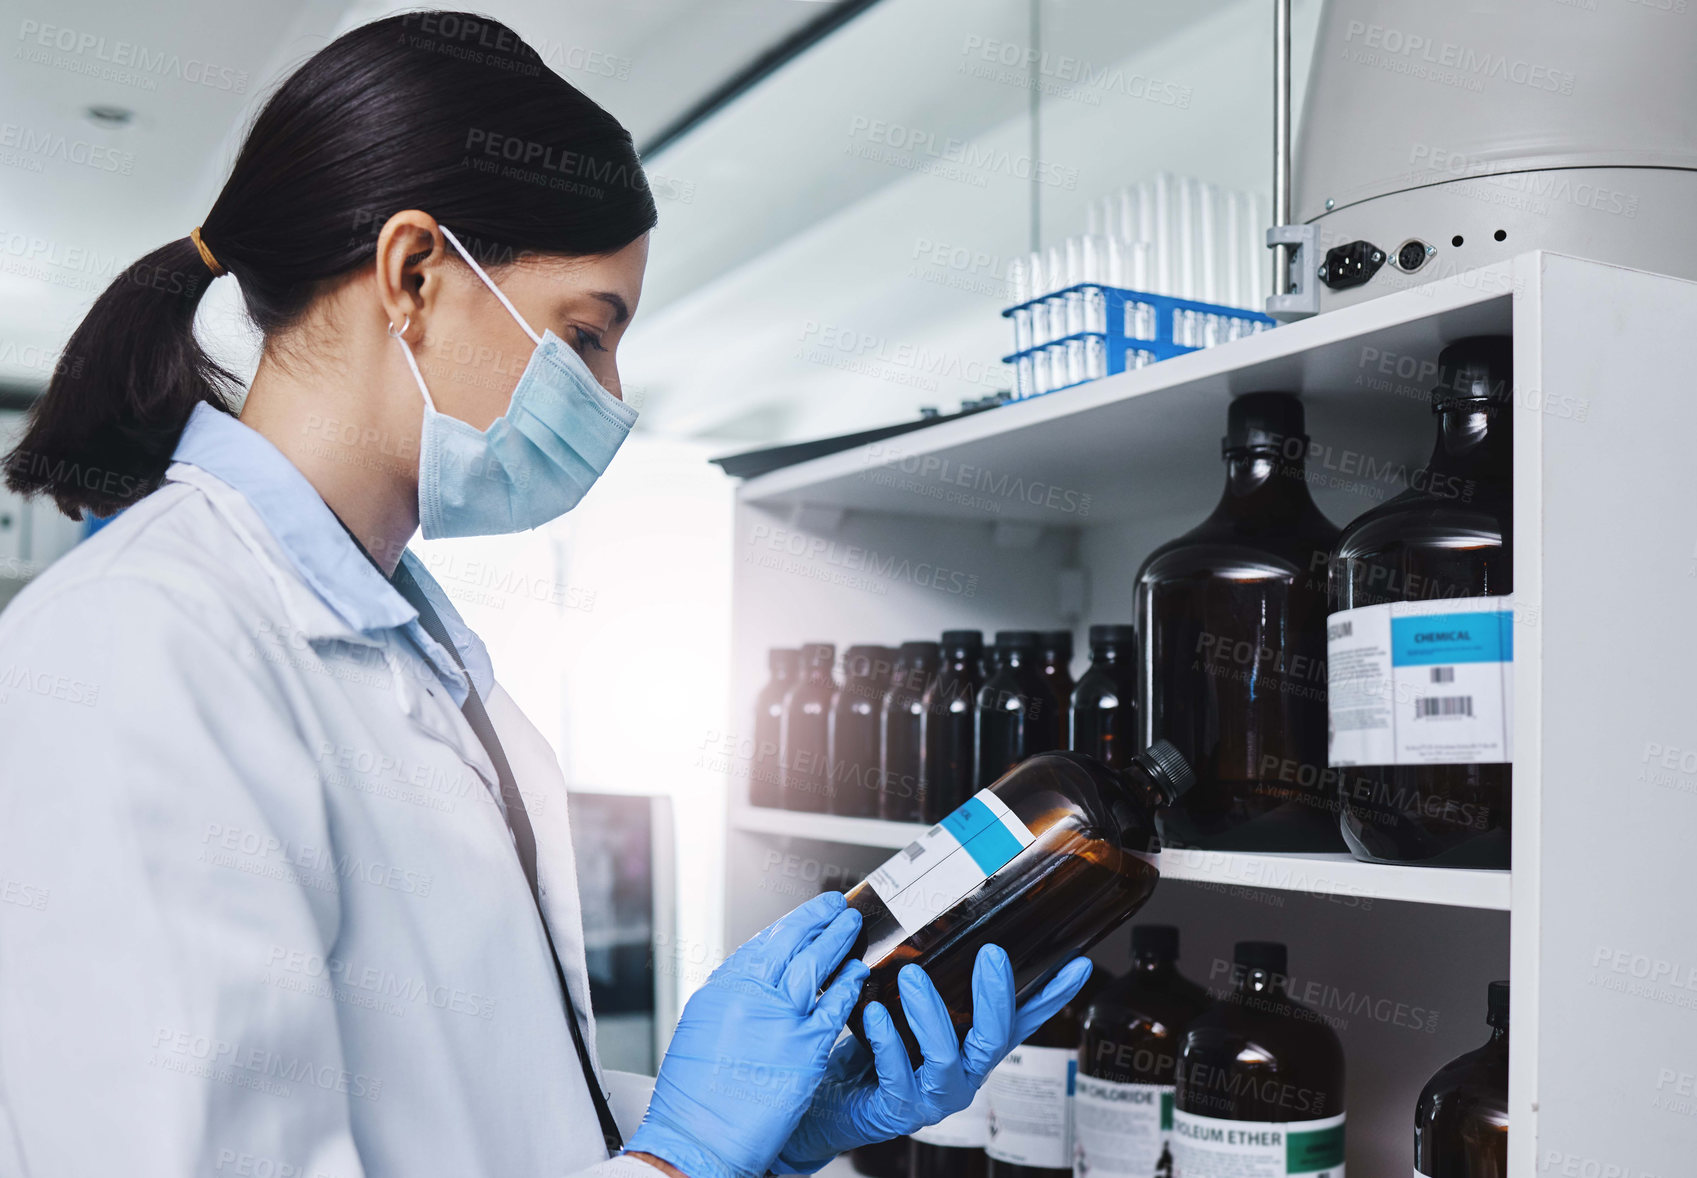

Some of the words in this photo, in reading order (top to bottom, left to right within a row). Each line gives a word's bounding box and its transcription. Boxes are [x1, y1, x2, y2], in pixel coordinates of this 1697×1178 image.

[1414, 630, 1471, 644] CHEMICAL
[1090, 1085, 1154, 1105] CHLORIDE
[1227, 1130, 1282, 1146] ETHER
